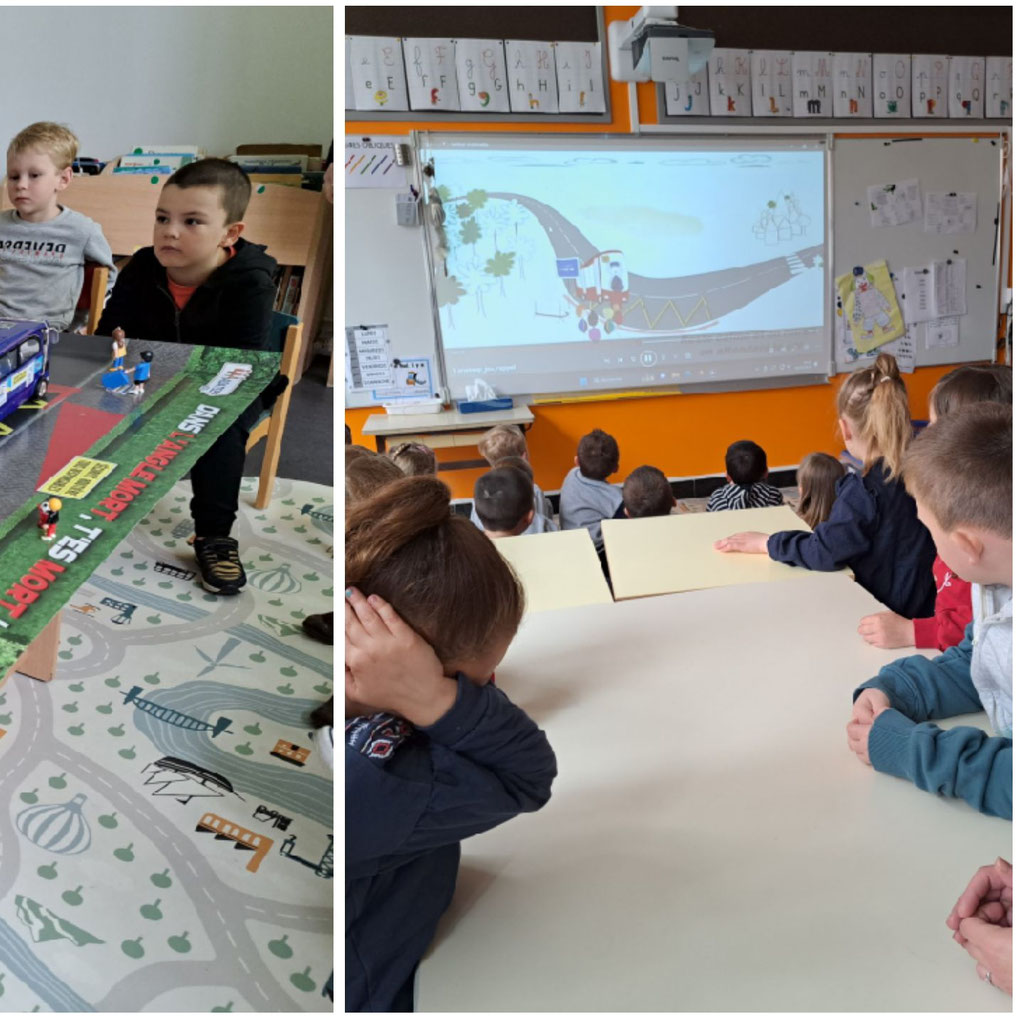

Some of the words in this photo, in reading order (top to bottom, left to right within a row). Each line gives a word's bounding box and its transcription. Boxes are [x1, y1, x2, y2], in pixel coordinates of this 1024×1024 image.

[177, 403, 221, 434] DANS
[129, 431, 195, 482] L'ANGLE
[48, 524, 103, 563] T'ES
